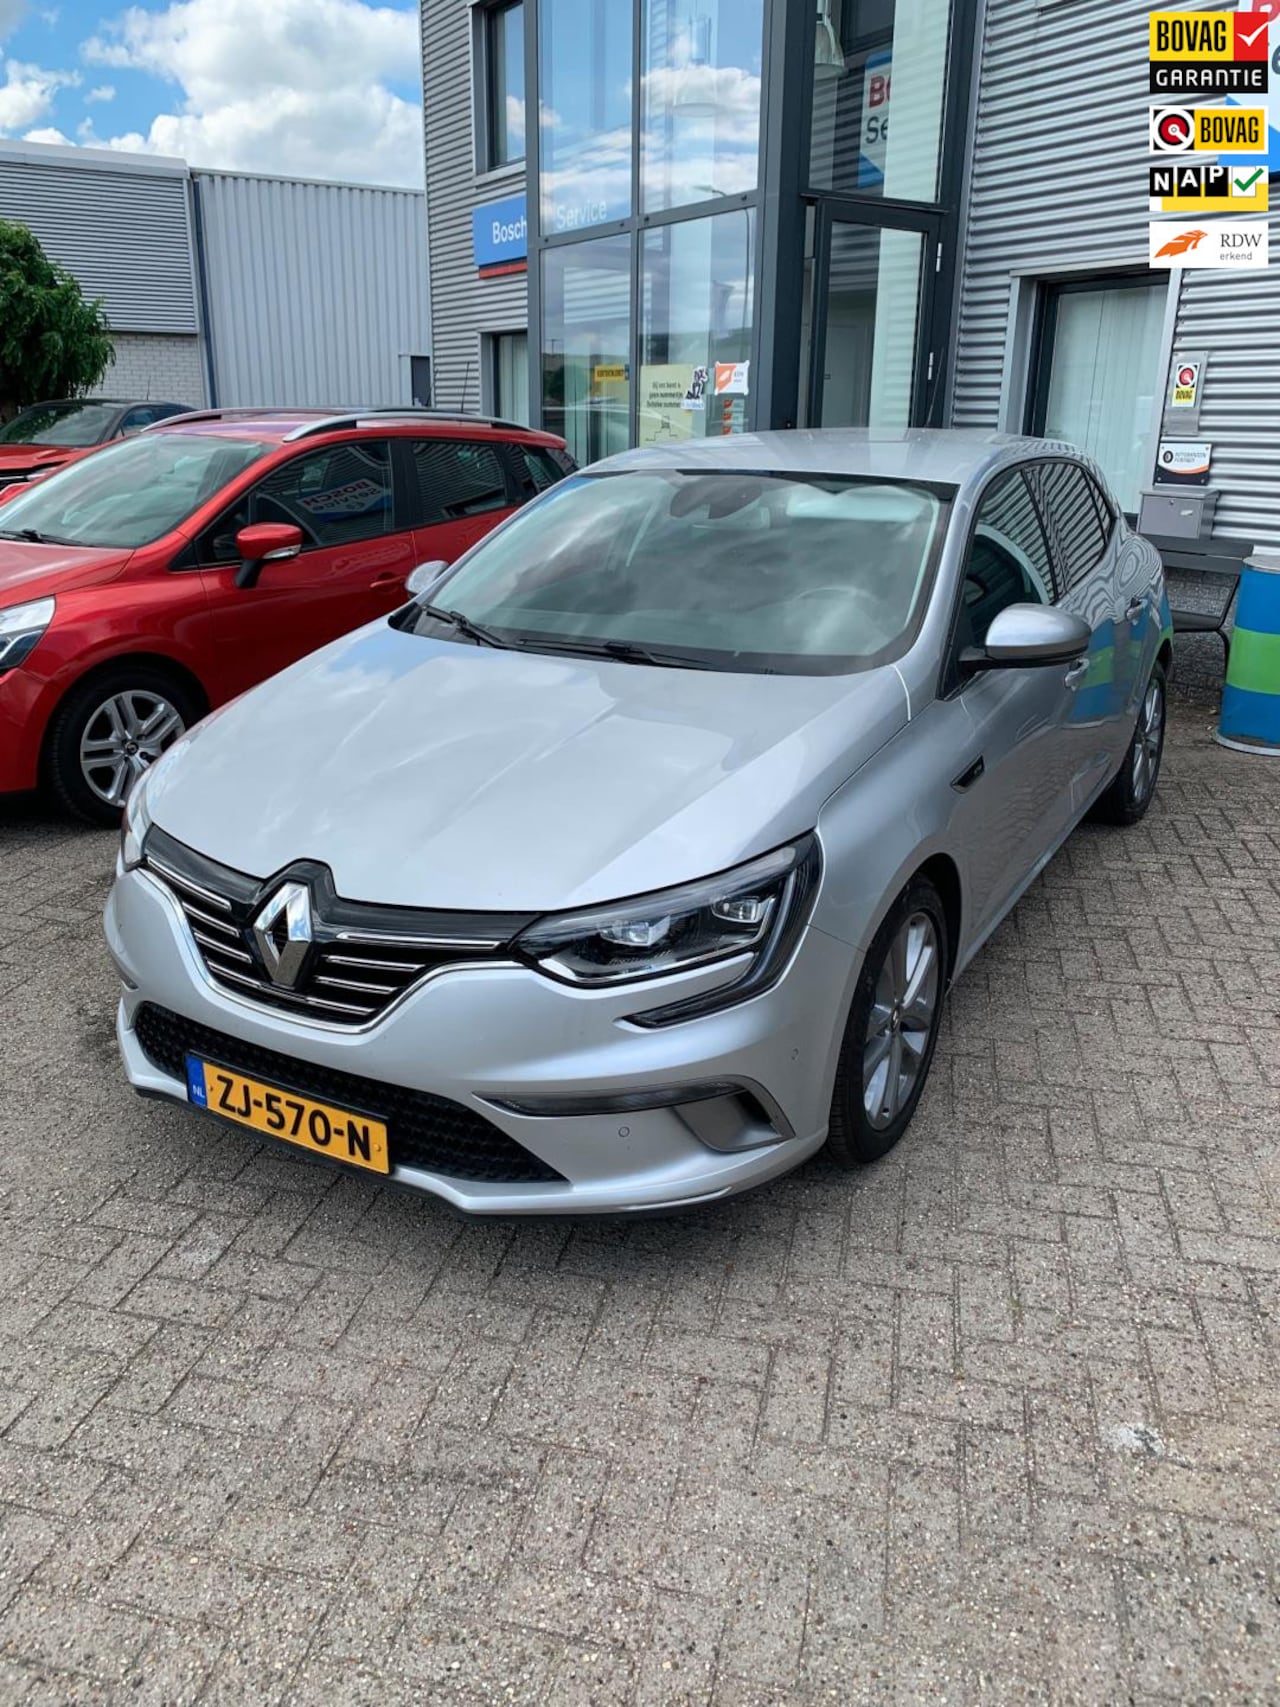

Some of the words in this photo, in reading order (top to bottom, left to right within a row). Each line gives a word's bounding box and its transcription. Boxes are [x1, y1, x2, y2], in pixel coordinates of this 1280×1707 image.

[556, 200, 607, 229] Service
[192, 1084, 206, 1098] NL
[216, 1074, 371, 1163] ZJ-570-N
